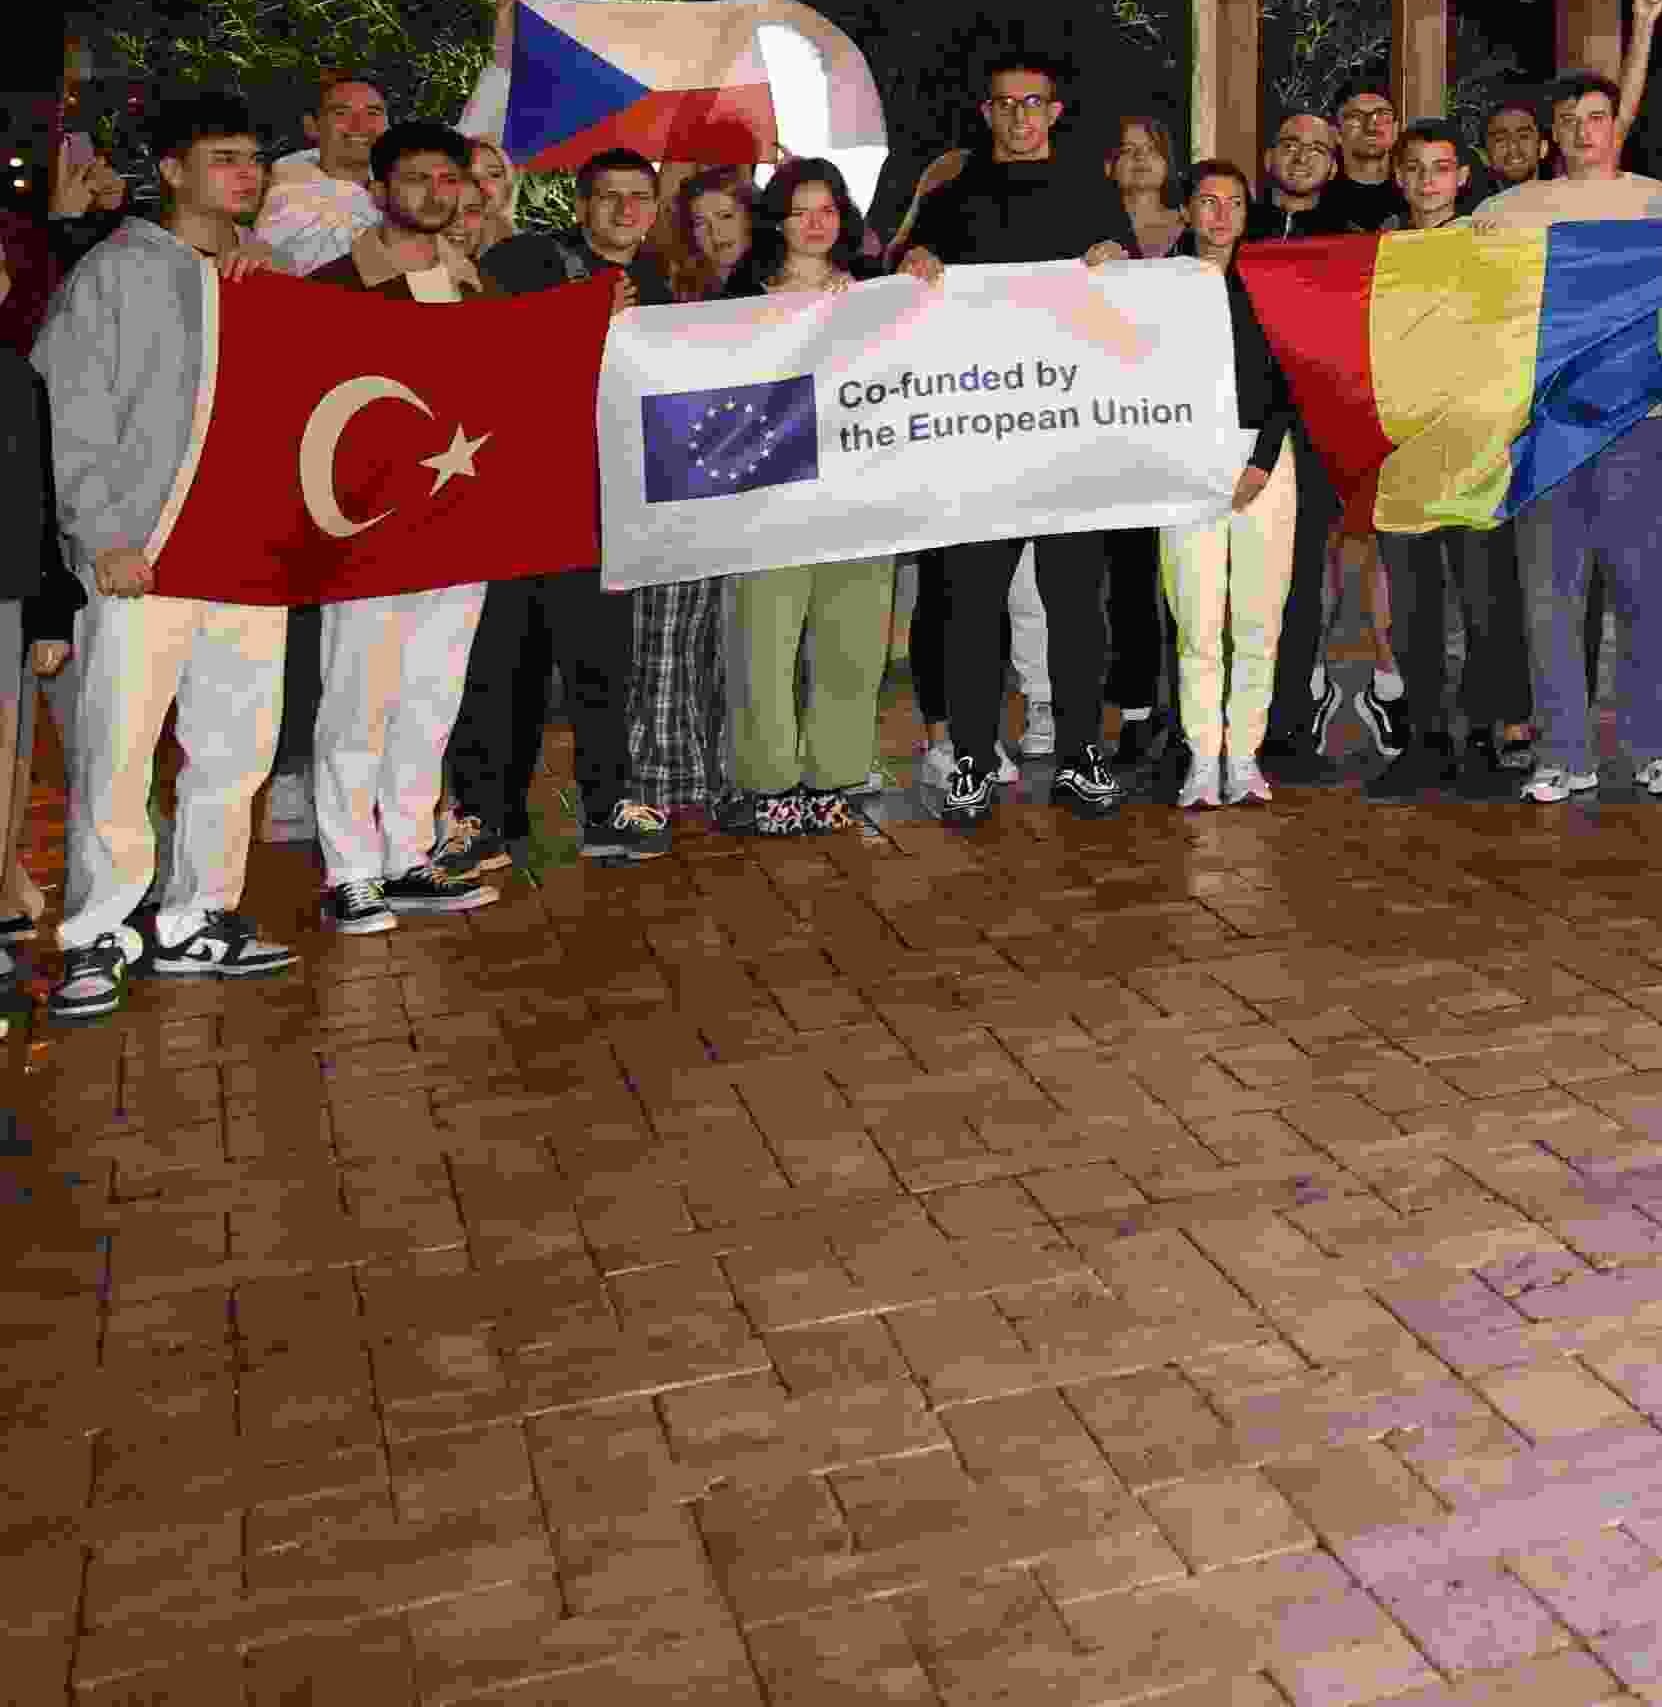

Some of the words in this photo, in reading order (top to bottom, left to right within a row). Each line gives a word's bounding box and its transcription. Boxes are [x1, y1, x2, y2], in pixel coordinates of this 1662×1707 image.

[838, 362, 1024, 409] Co-funded
[1036, 360, 1078, 391] by
[839, 422, 897, 452] the
[907, 407, 1080, 442] European
[1091, 398, 1193, 426] Union
